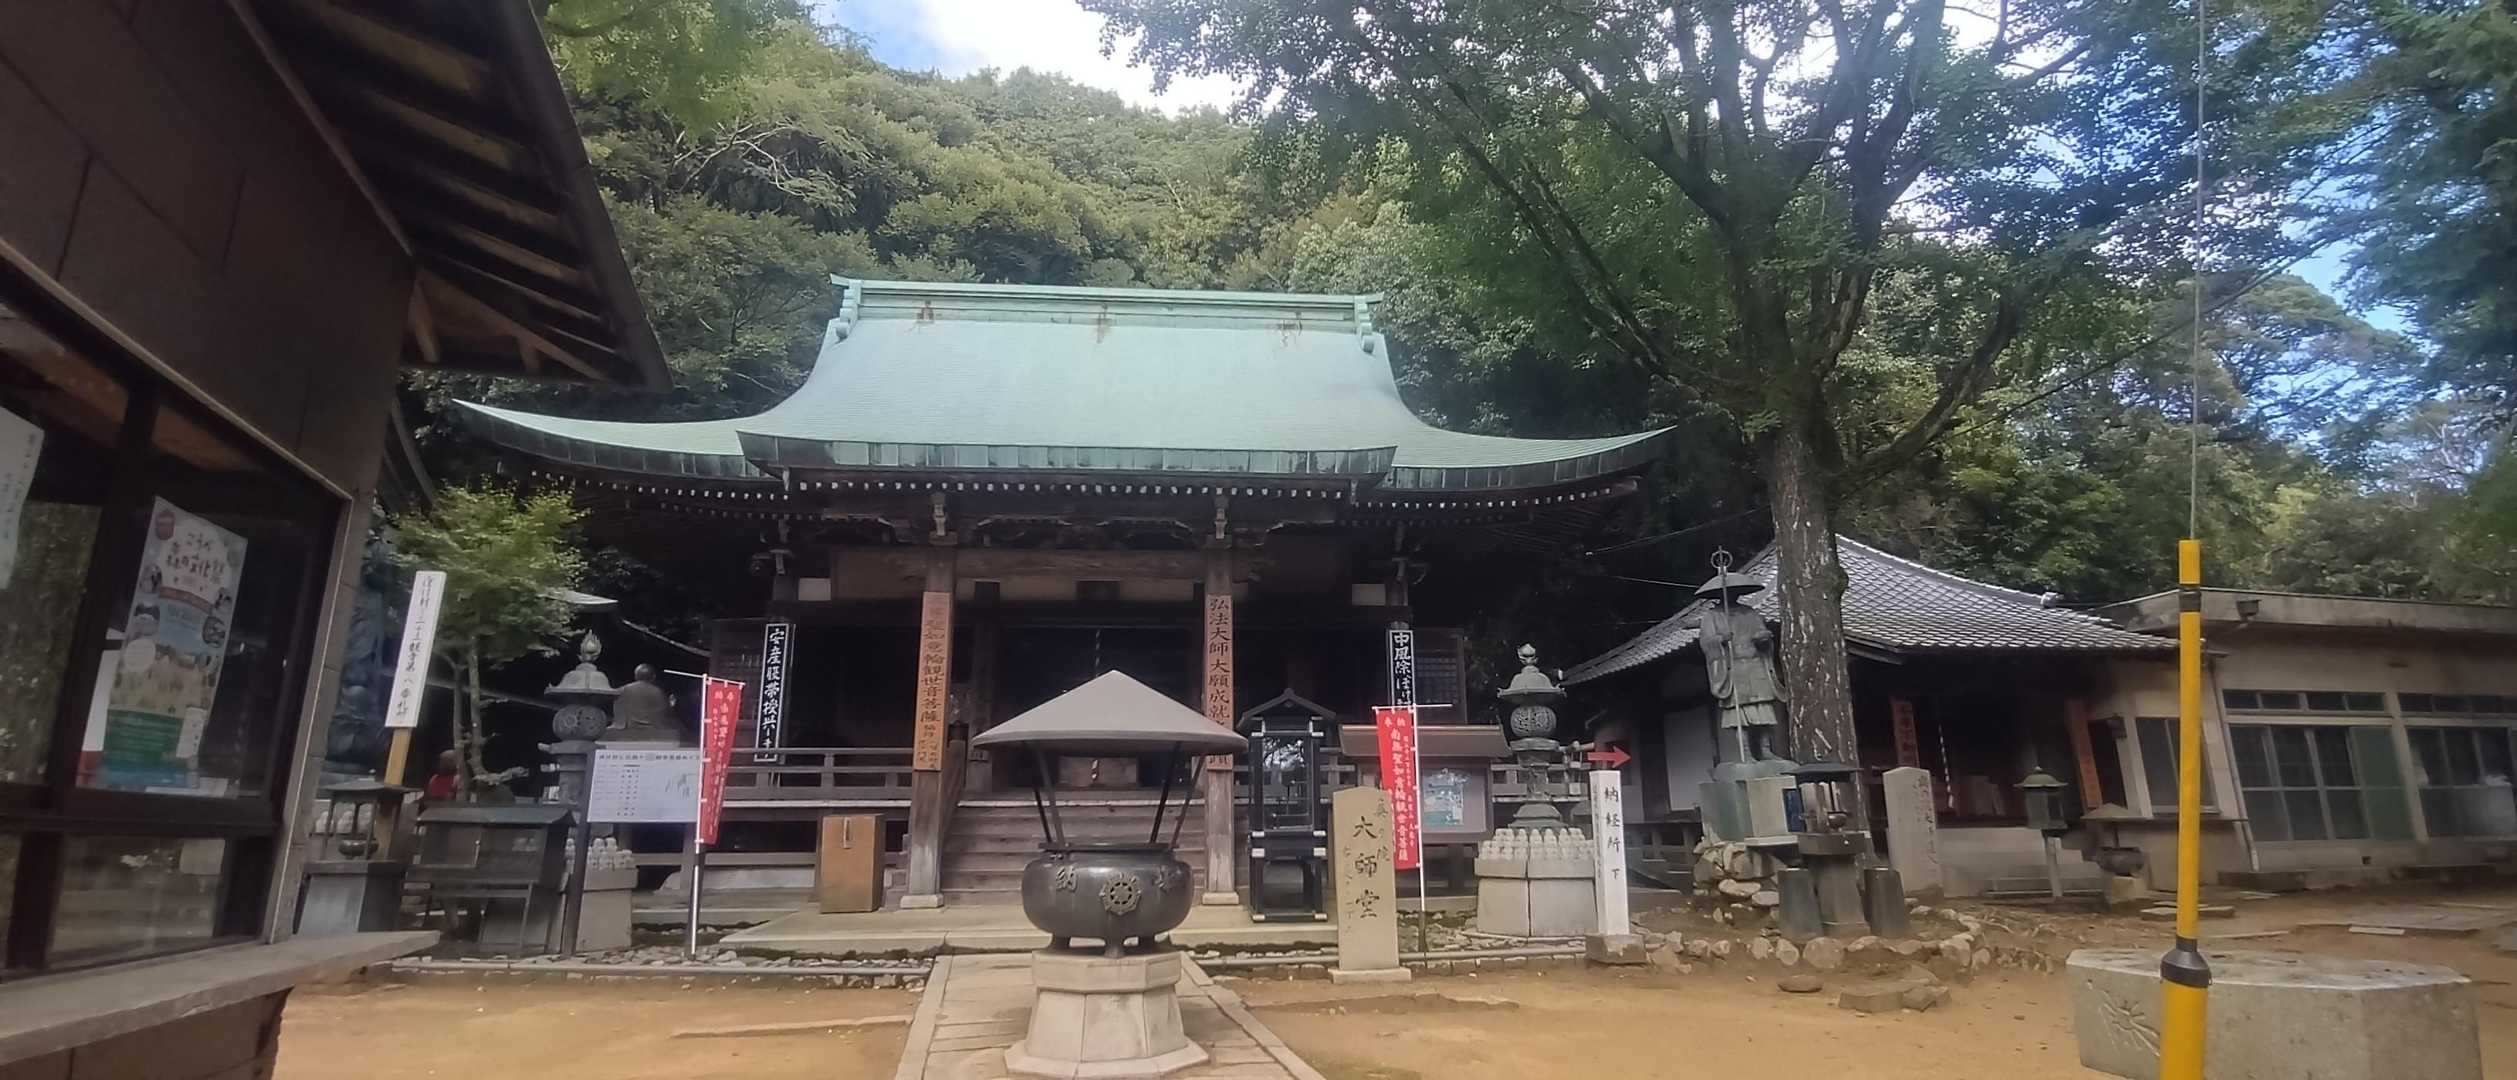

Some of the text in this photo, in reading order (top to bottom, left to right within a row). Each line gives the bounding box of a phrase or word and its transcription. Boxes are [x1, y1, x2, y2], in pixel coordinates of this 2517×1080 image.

[1208, 598, 1231, 765] 弘法大師大願成就
[1353, 815, 1380, 919] 大師堂
